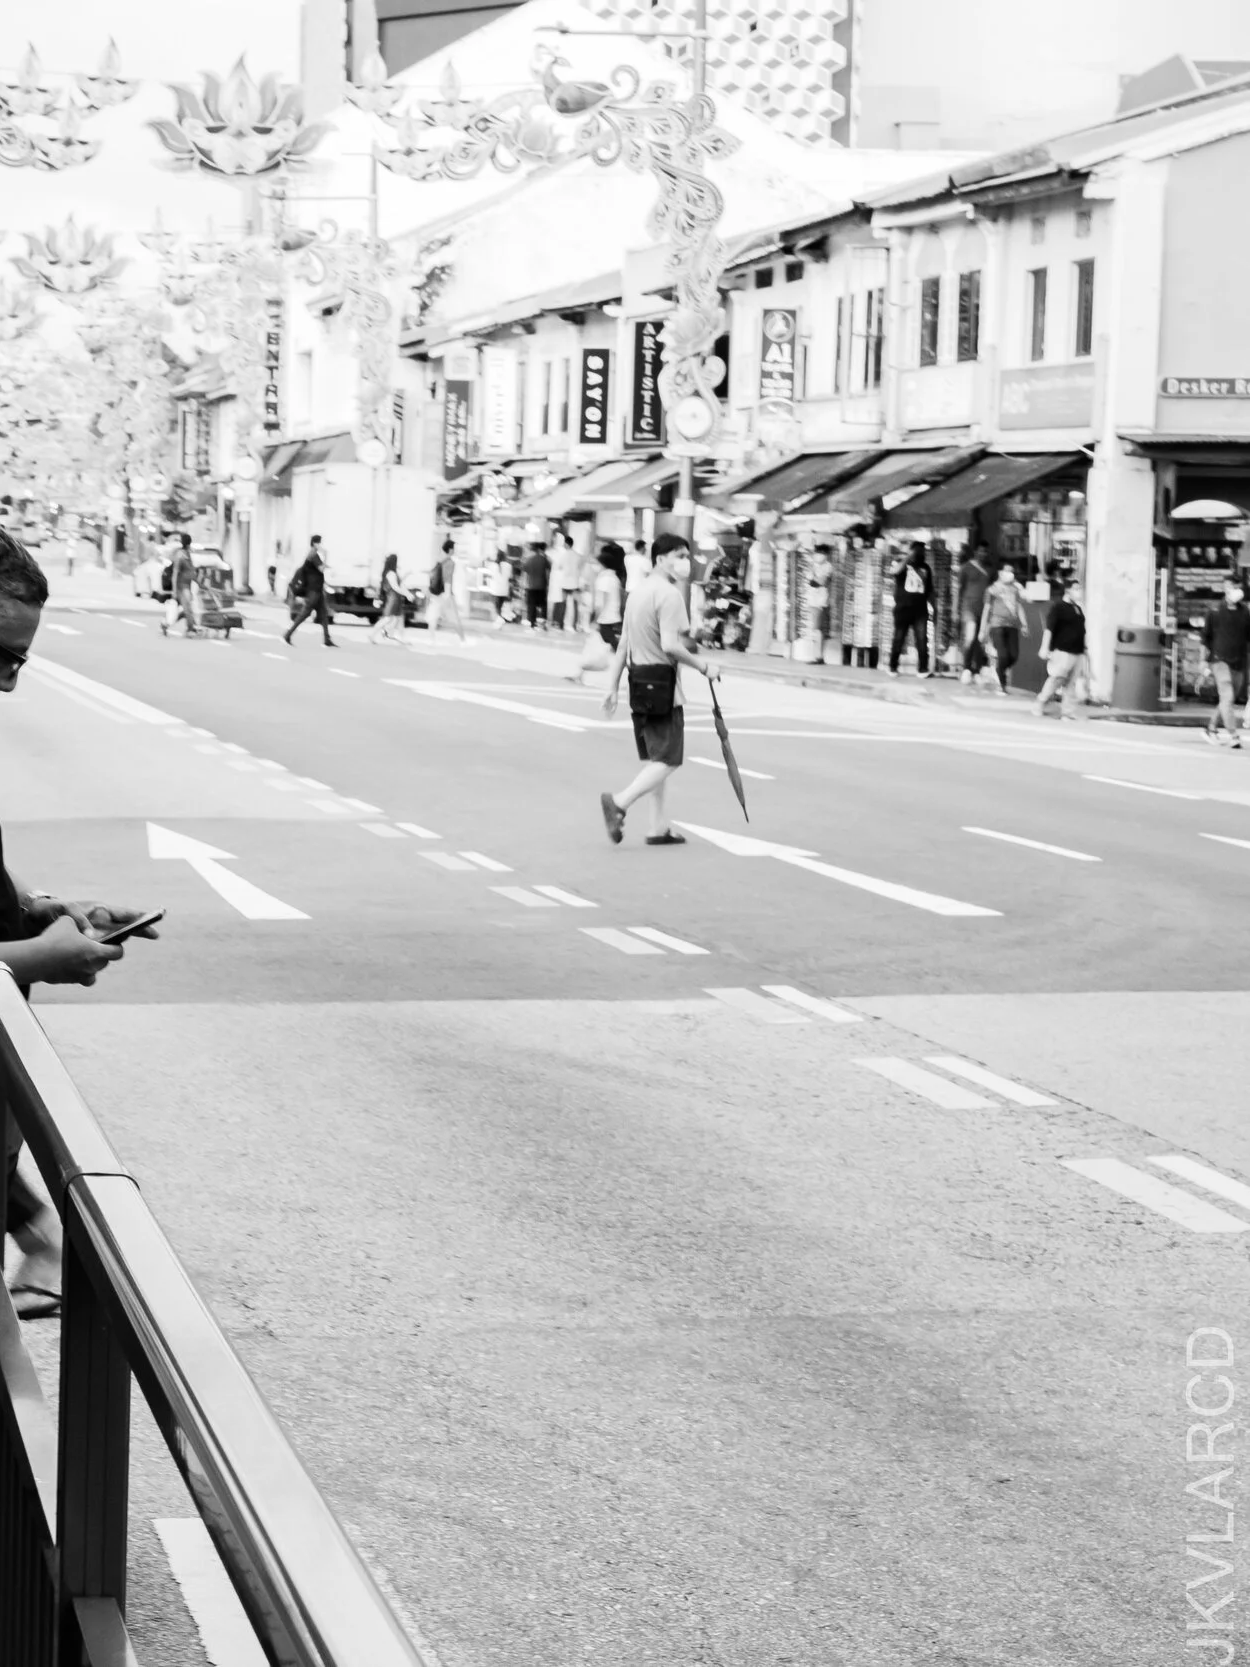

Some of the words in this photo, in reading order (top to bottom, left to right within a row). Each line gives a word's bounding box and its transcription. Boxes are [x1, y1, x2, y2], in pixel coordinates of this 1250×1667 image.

[639, 322, 657, 431] ARTISTIC
[1167, 378, 1230, 395] Desker
[1235, 378, 1250, 395] R
